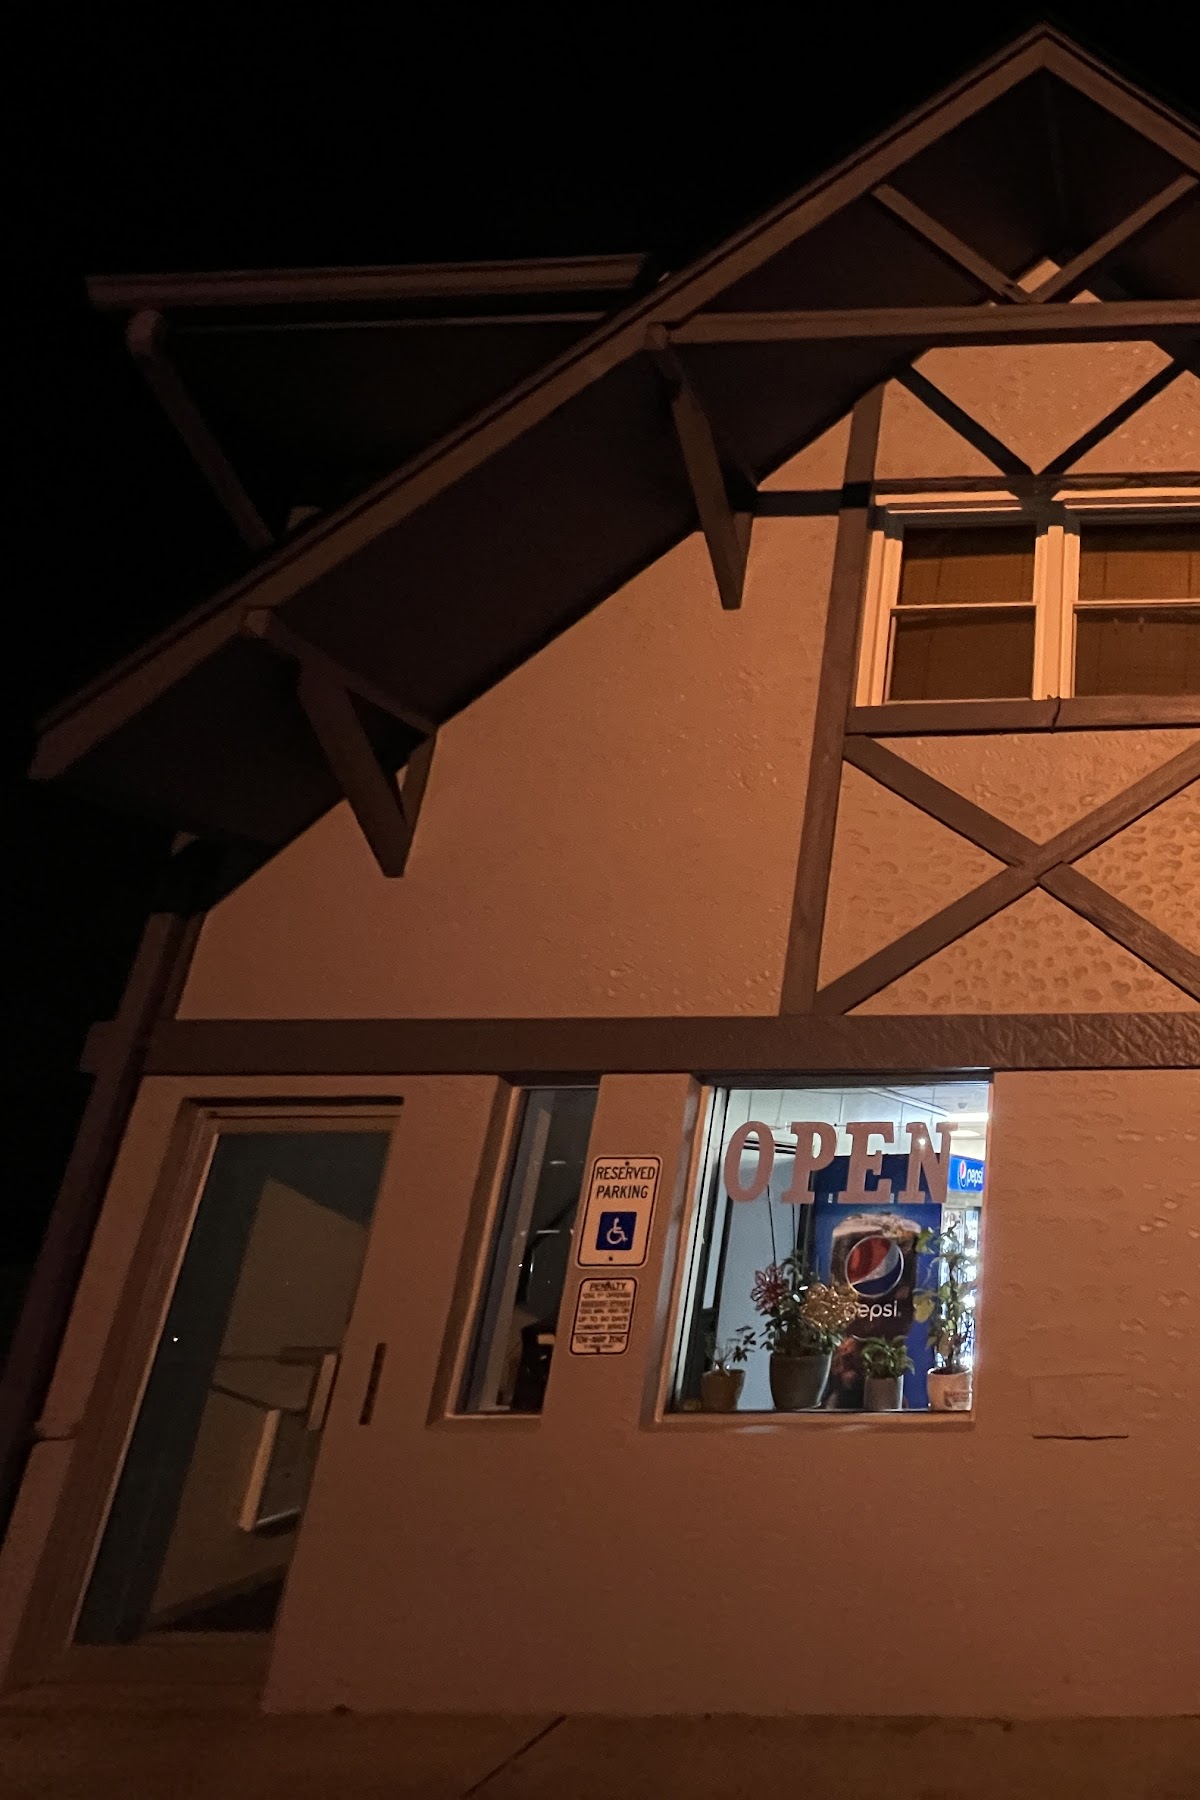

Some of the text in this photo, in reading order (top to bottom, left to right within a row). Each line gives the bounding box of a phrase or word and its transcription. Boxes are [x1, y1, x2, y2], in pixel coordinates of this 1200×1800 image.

[723, 1120, 959, 1204] OPEN
[595, 1166, 656, 1180] RESERVED
[966, 1166, 984, 1188] pepsi
[596, 1185, 649, 1199] PARKING
[589, 1282, 626, 1292] PENALTY
[844, 1300, 898, 1322] pepsi
